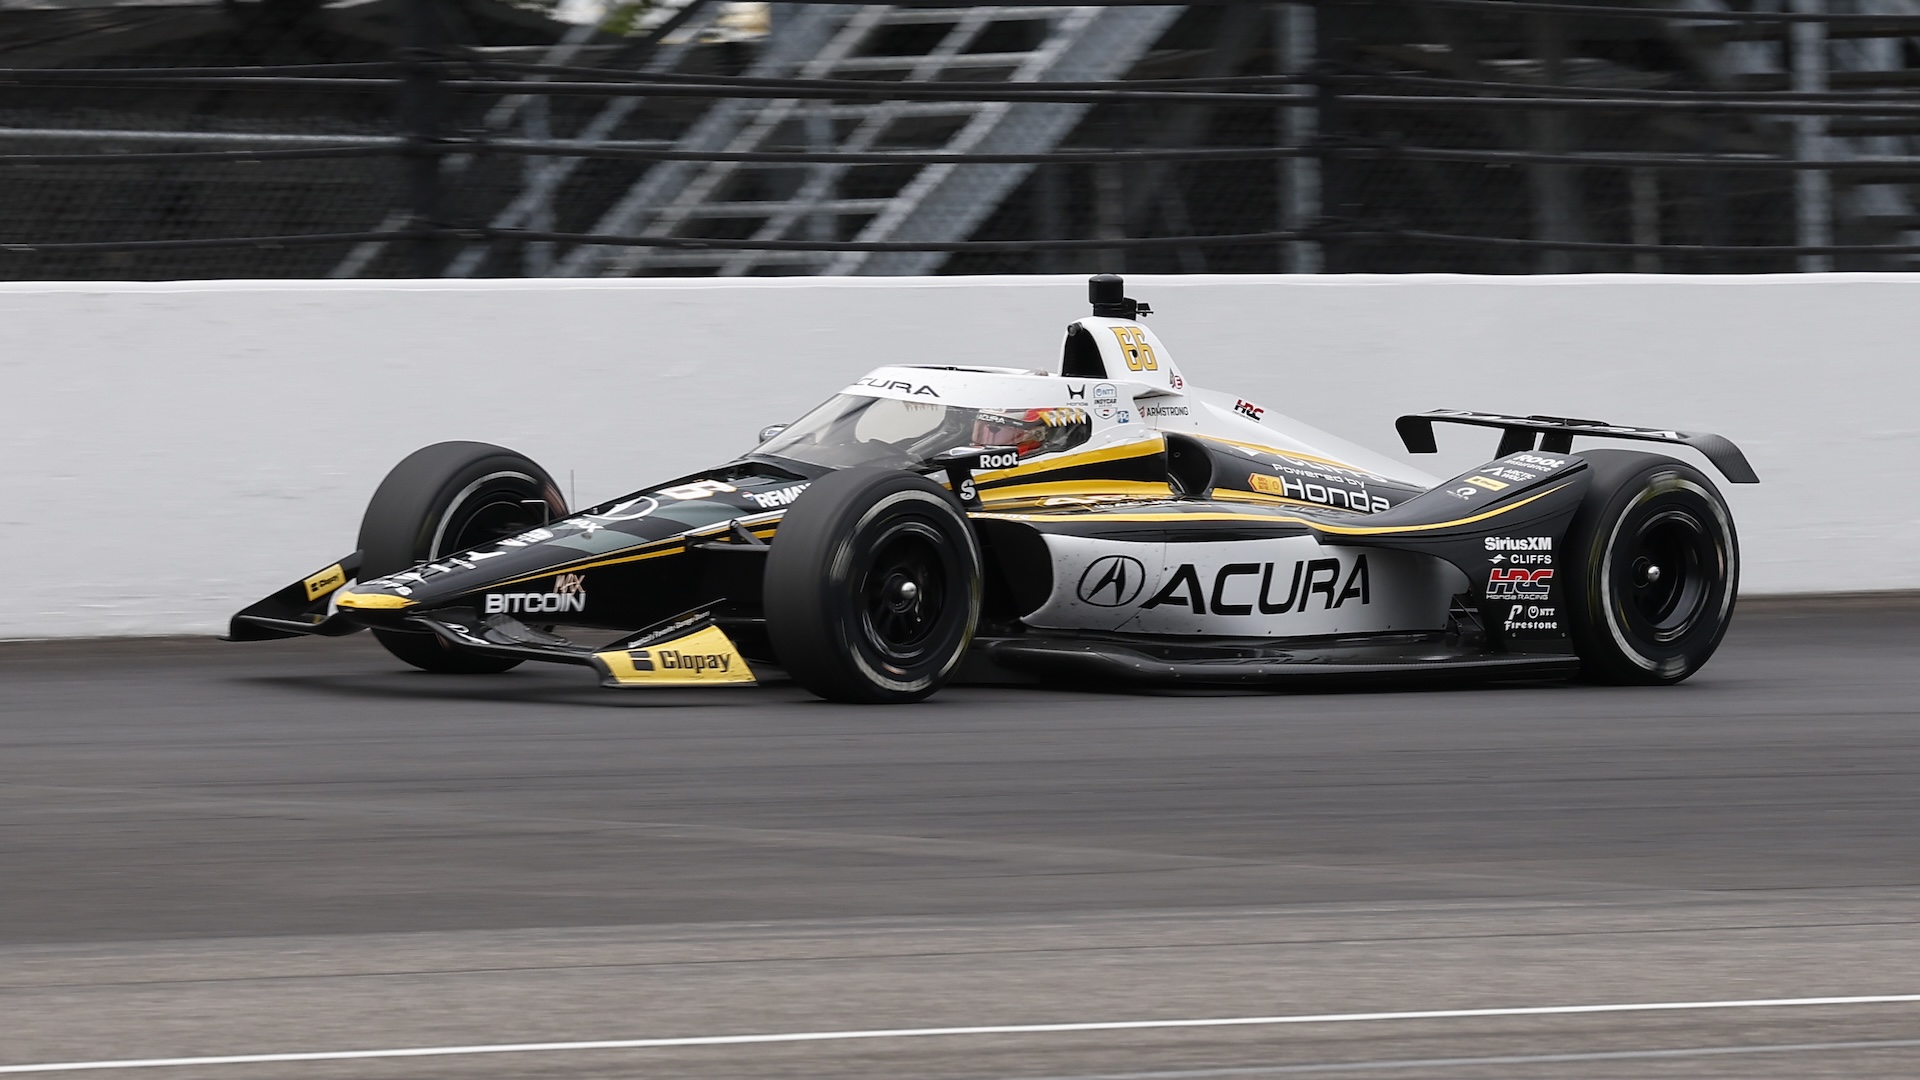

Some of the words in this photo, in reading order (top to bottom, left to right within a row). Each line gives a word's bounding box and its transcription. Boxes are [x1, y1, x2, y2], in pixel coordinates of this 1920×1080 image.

[1108, 326, 1158, 371] 66
[851, 378, 941, 398] CURA
[1147, 406, 1189, 417] ARMSTRONG
[1234, 399, 1264, 421] HRC
[980, 452, 1019, 468] Root
[1513, 454, 1565, 468] Root
[1271, 463, 1344, 483] Powered
[1344, 476, 1365, 488] by
[1280, 475, 1390, 513] Honda
[1484, 536, 1552, 551] SiriusXM
[1510, 554, 1552, 564] CLIFFS
[553, 573, 585, 594] MAX
[1138, 554, 1370, 616] ACURA
[1486, 568, 1554, 594] HRC
[485, 593, 586, 614] BITCOIN
[1540, 607, 1555, 616] NTT
[1504, 620, 1557, 631] Firestone
[658, 650, 731, 673] Clopay
